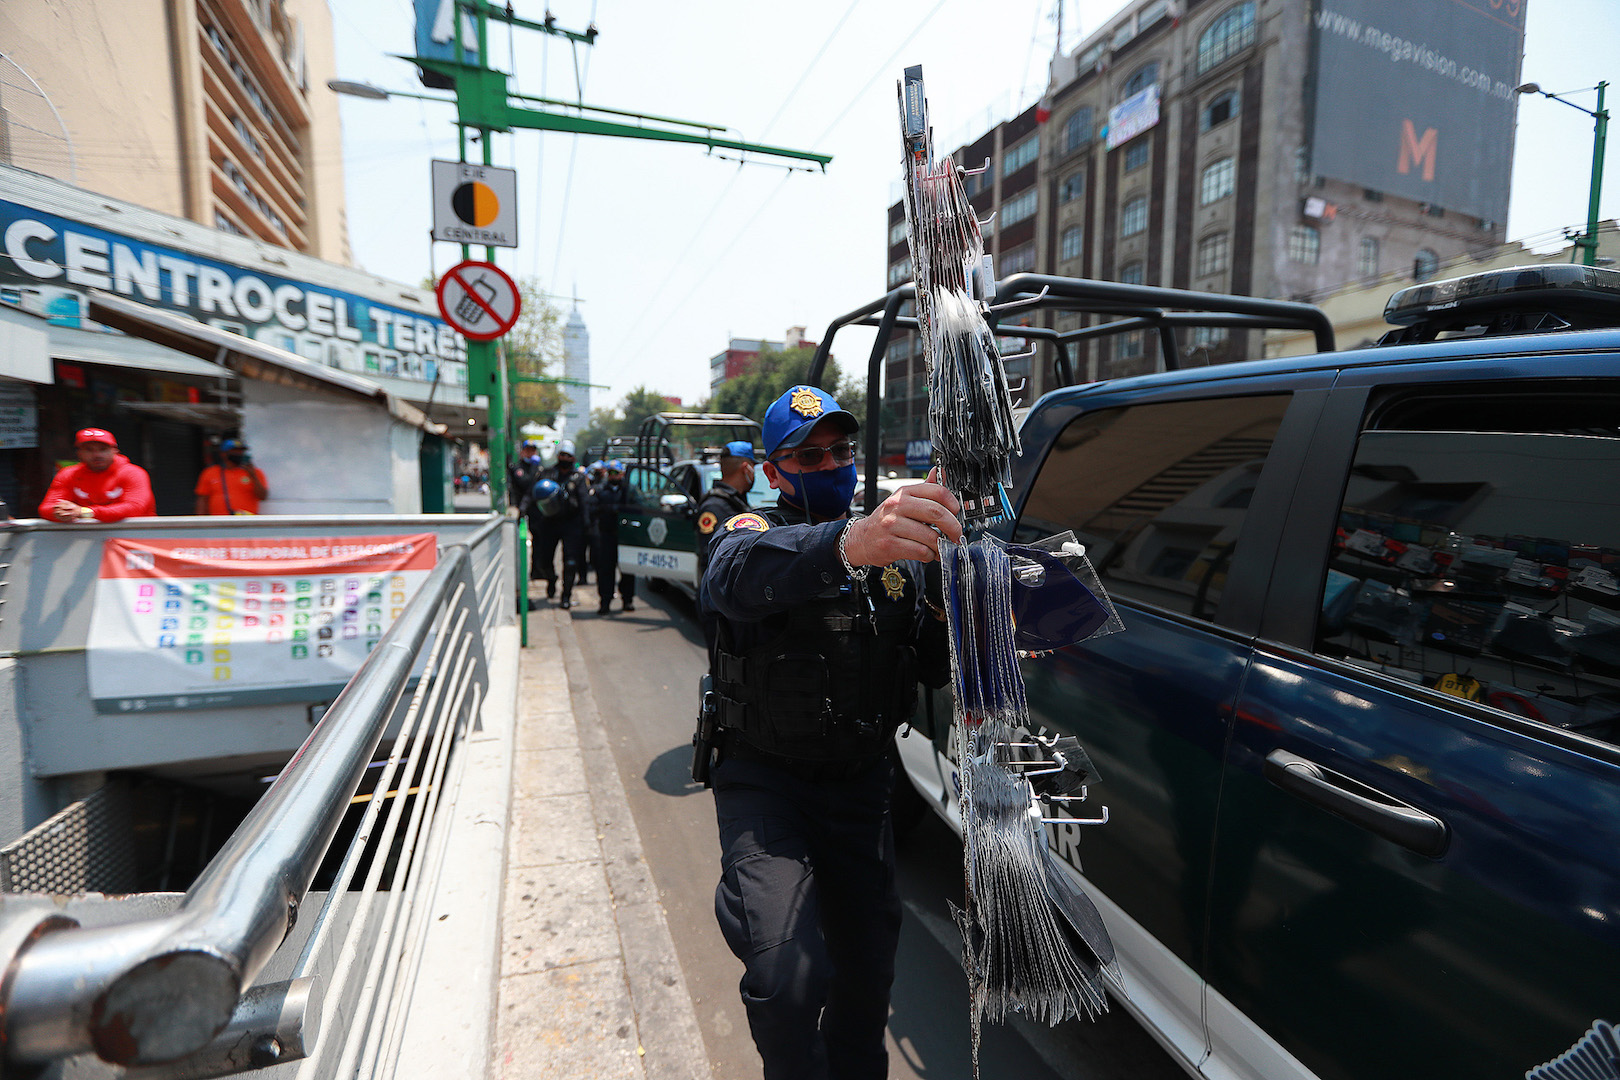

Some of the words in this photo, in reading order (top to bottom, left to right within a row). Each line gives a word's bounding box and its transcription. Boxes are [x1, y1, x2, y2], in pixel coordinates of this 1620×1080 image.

[1397, 118, 1438, 182] M
[443, 227, 509, 244] CENTRAL
[3, 218, 362, 342] CENTROCEL
[229, 546, 309, 560] TEMPORAL
[310, 546, 331, 558] DE
